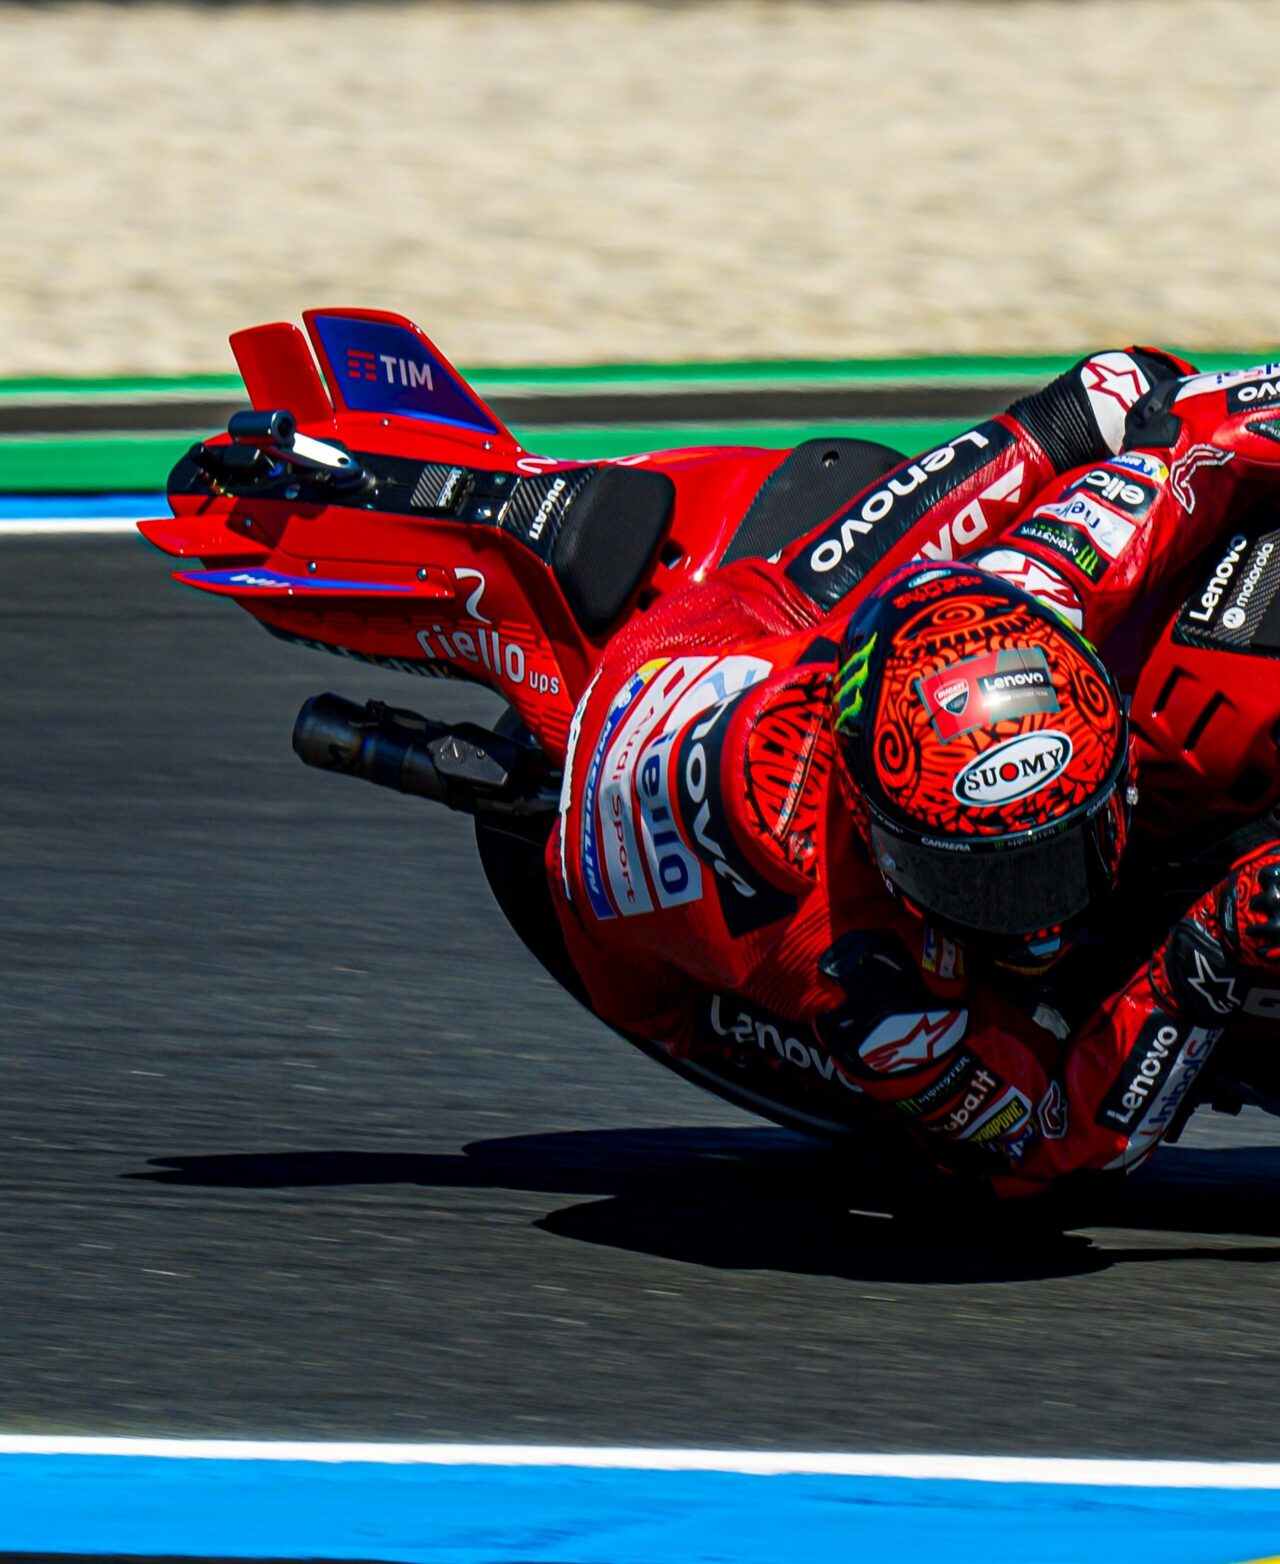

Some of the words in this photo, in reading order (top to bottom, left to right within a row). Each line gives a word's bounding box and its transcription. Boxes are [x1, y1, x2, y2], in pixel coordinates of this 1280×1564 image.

[380, 355, 434, 391] TIM
[529, 478, 566, 541] DUCATI
[811, 431, 989, 572] Lenovo
[1085, 470, 1145, 505] elic
[1189, 534, 1248, 622] Lenovo
[1235, 542, 1274, 608] motorola
[416, 625, 525, 683] riello
[529, 672, 560, 695] ups
[983, 671, 1044, 691] Lenovo
[612, 705, 655, 781] Audi
[965, 747, 1062, 791] SUOMY
[583, 722, 612, 895] MICHELIN
[640, 728, 690, 896] iello
[686, 698, 757, 897] nov
[611, 795, 636, 904] Sport
[921, 836, 971, 853] CARRERA
[942, 1069, 999, 1132] uba.it
[1106, 1025, 1180, 1125] Lenovo
